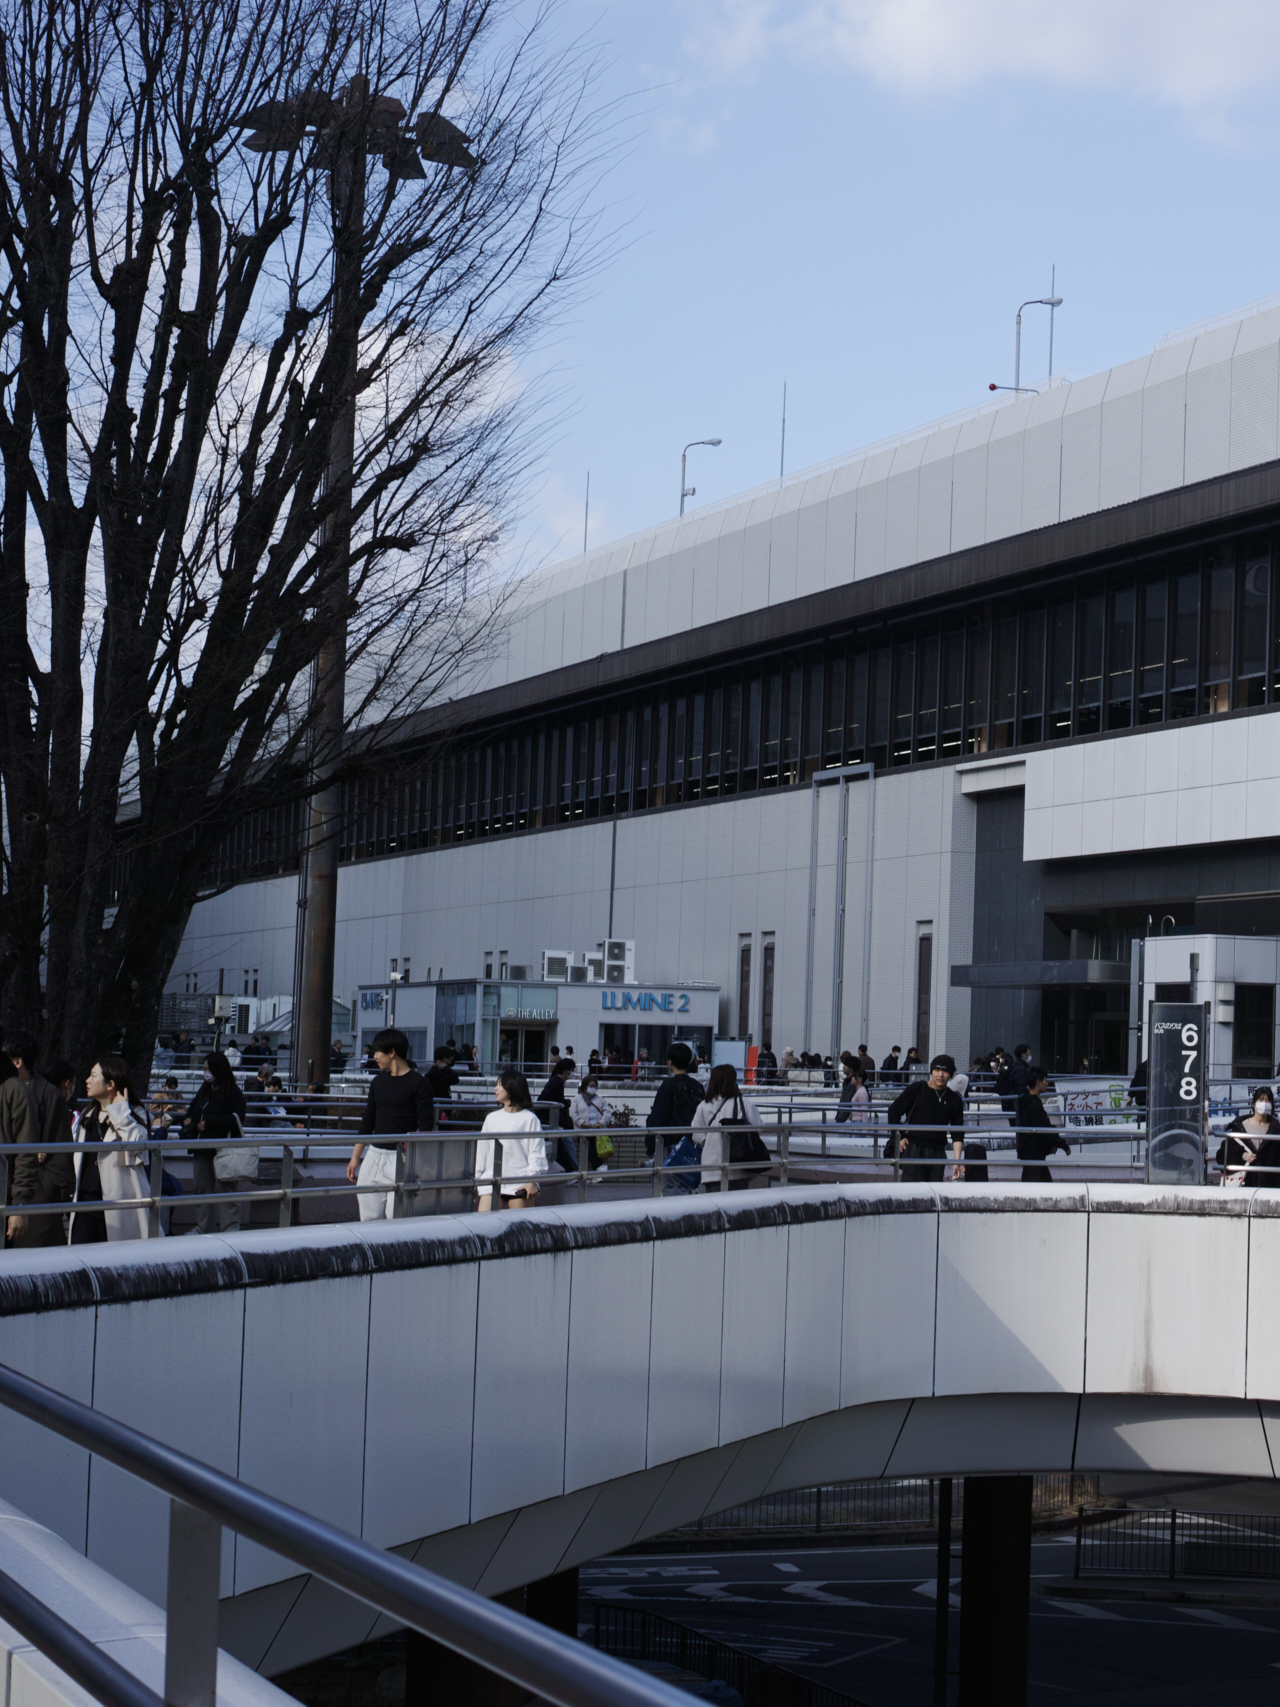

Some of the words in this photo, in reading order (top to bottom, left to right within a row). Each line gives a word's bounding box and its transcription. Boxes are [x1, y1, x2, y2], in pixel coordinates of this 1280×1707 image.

[602, 991, 674, 1012] LUMINE
[677, 993, 690, 1012] 2
[518, 1008, 530, 1018] THE
[532, 1008, 554, 1019] ALLEY
[1181, 1023, 1198, 1047] 6
[1181, 1050, 1198, 1073] 7
[1179, 1077, 1197, 1100] 8
[1067, 1102, 1103, 1112] ネットで
